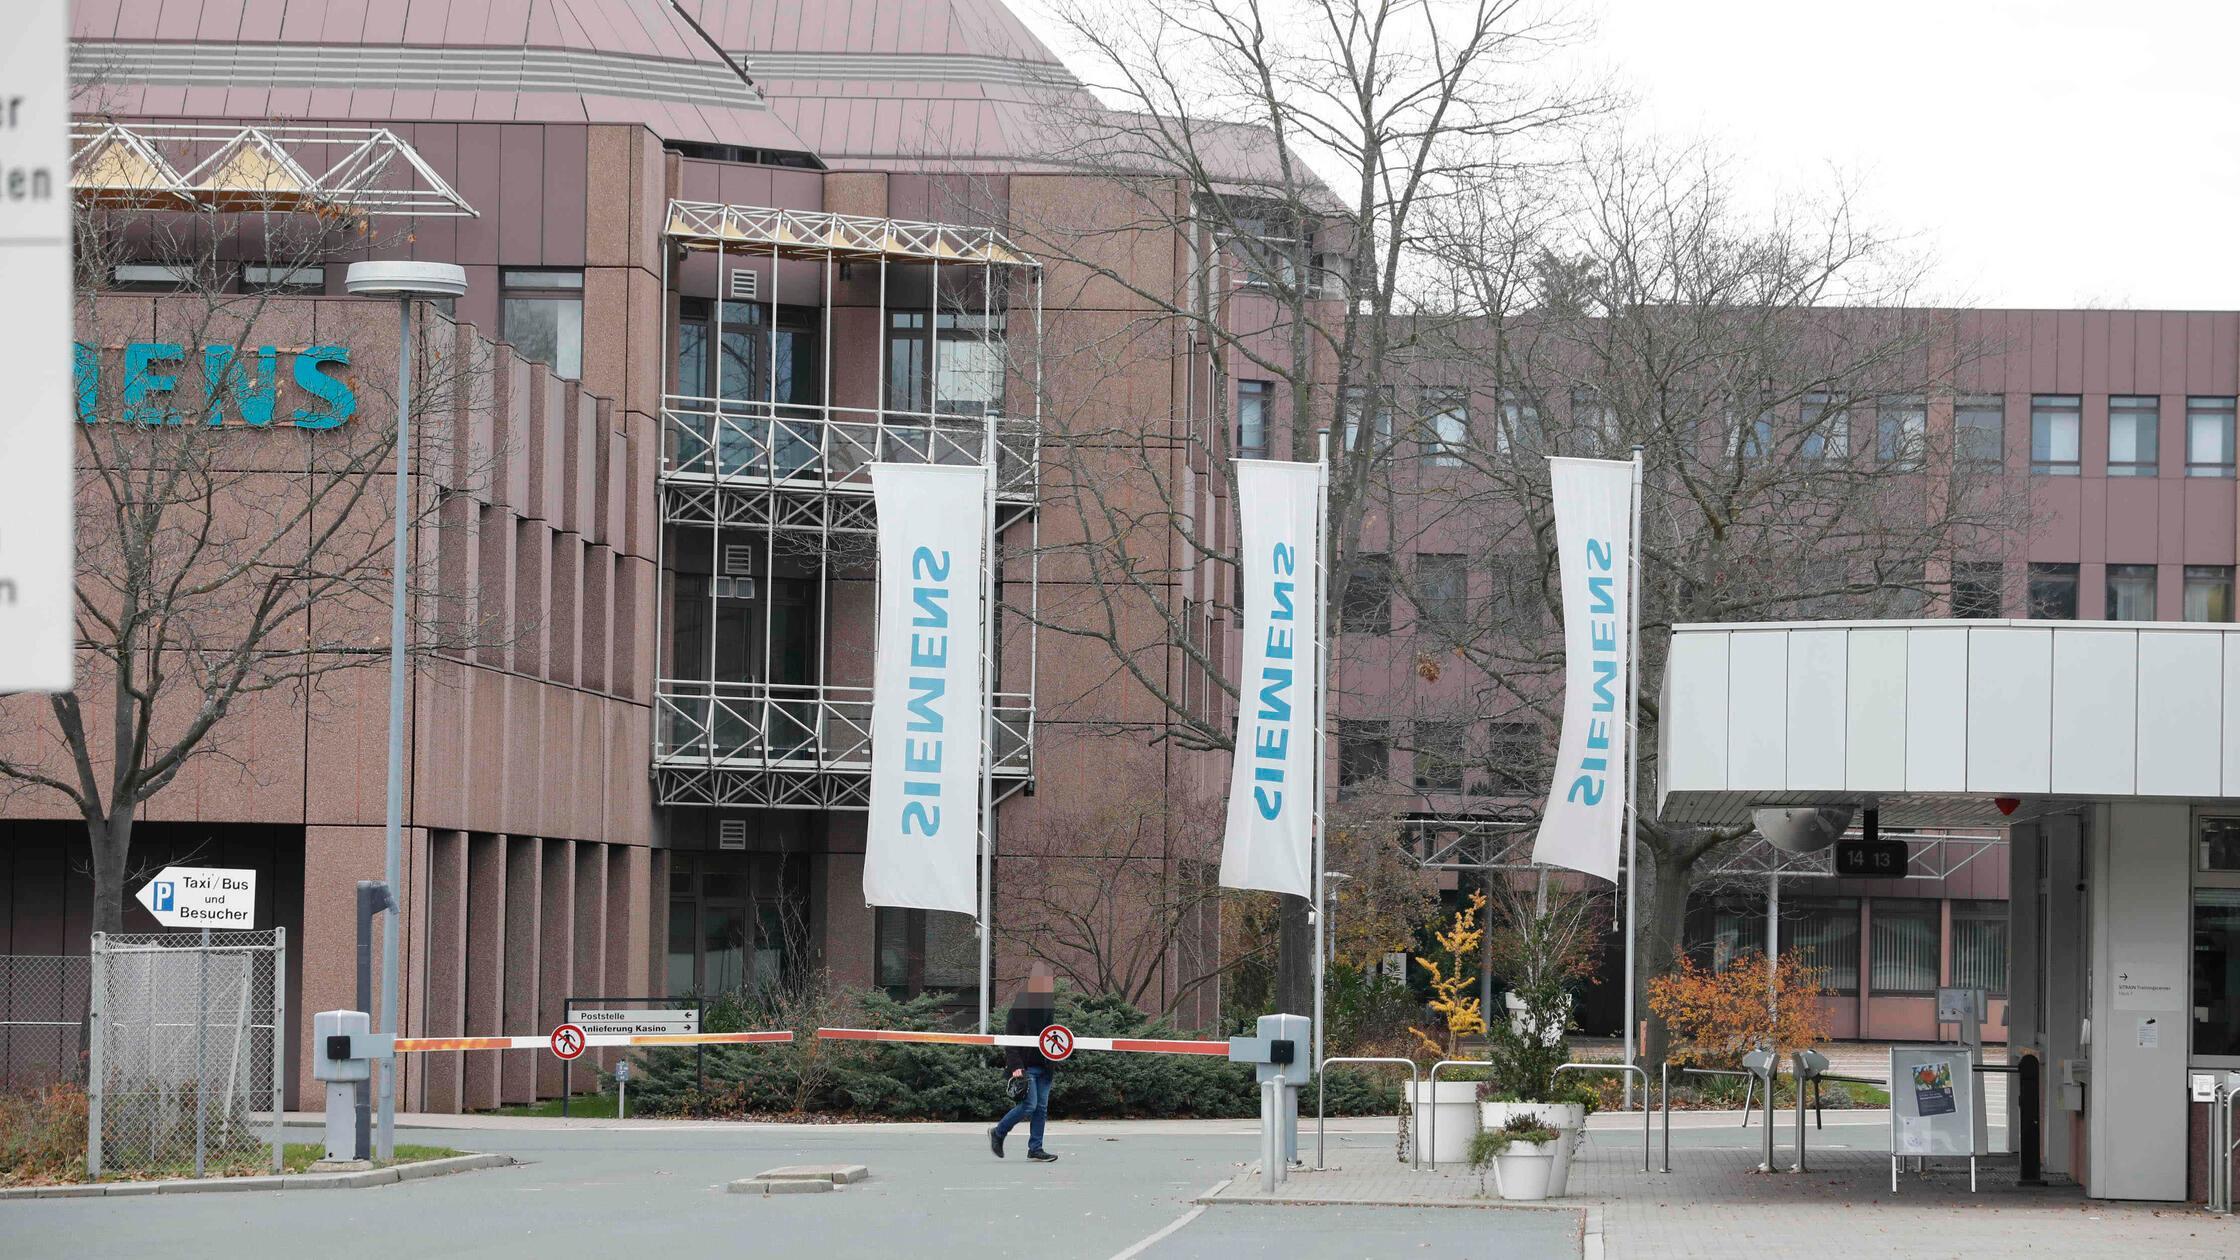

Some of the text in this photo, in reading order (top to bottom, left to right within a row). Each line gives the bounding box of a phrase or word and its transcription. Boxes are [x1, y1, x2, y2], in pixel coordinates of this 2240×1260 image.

[1848, 850, 1890, 867] 14 13
[156, 882, 172, 910] P
[205, 895, 225, 904] und
[180, 907, 248, 920] Besucher
[581, 1012, 625, 1020] Poststelle
[582, 1025, 667, 1034] Anlieferung Kasino
